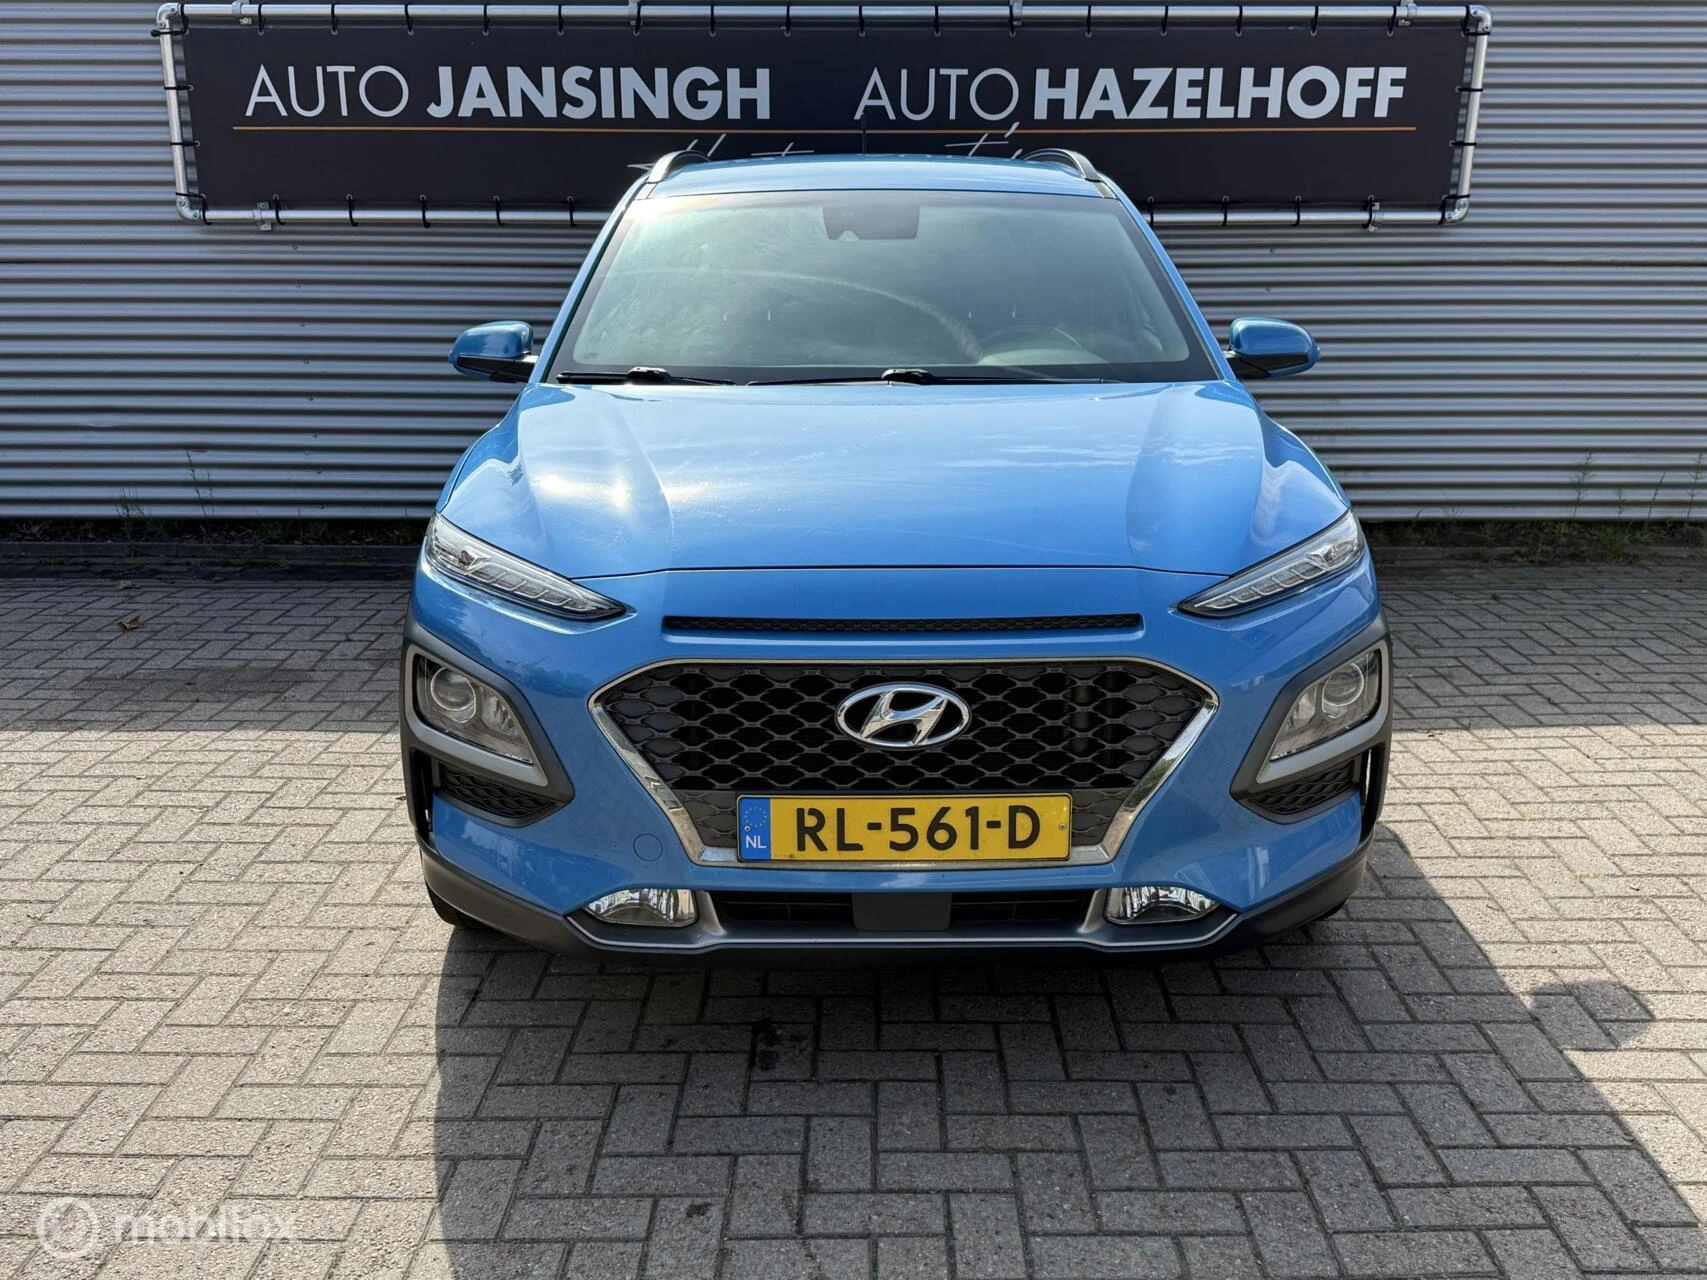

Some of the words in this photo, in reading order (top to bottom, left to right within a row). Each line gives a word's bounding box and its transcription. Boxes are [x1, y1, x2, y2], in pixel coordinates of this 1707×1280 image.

[245, 64, 409, 118] AUTO
[426, 66, 771, 120] JANSINGH
[854, 68, 1019, 121] AUTO
[1034, 66, 1407, 119] HAZELHOFF
[745, 835, 767, 849] NL
[796, 805, 1041, 851] RL-561-D
